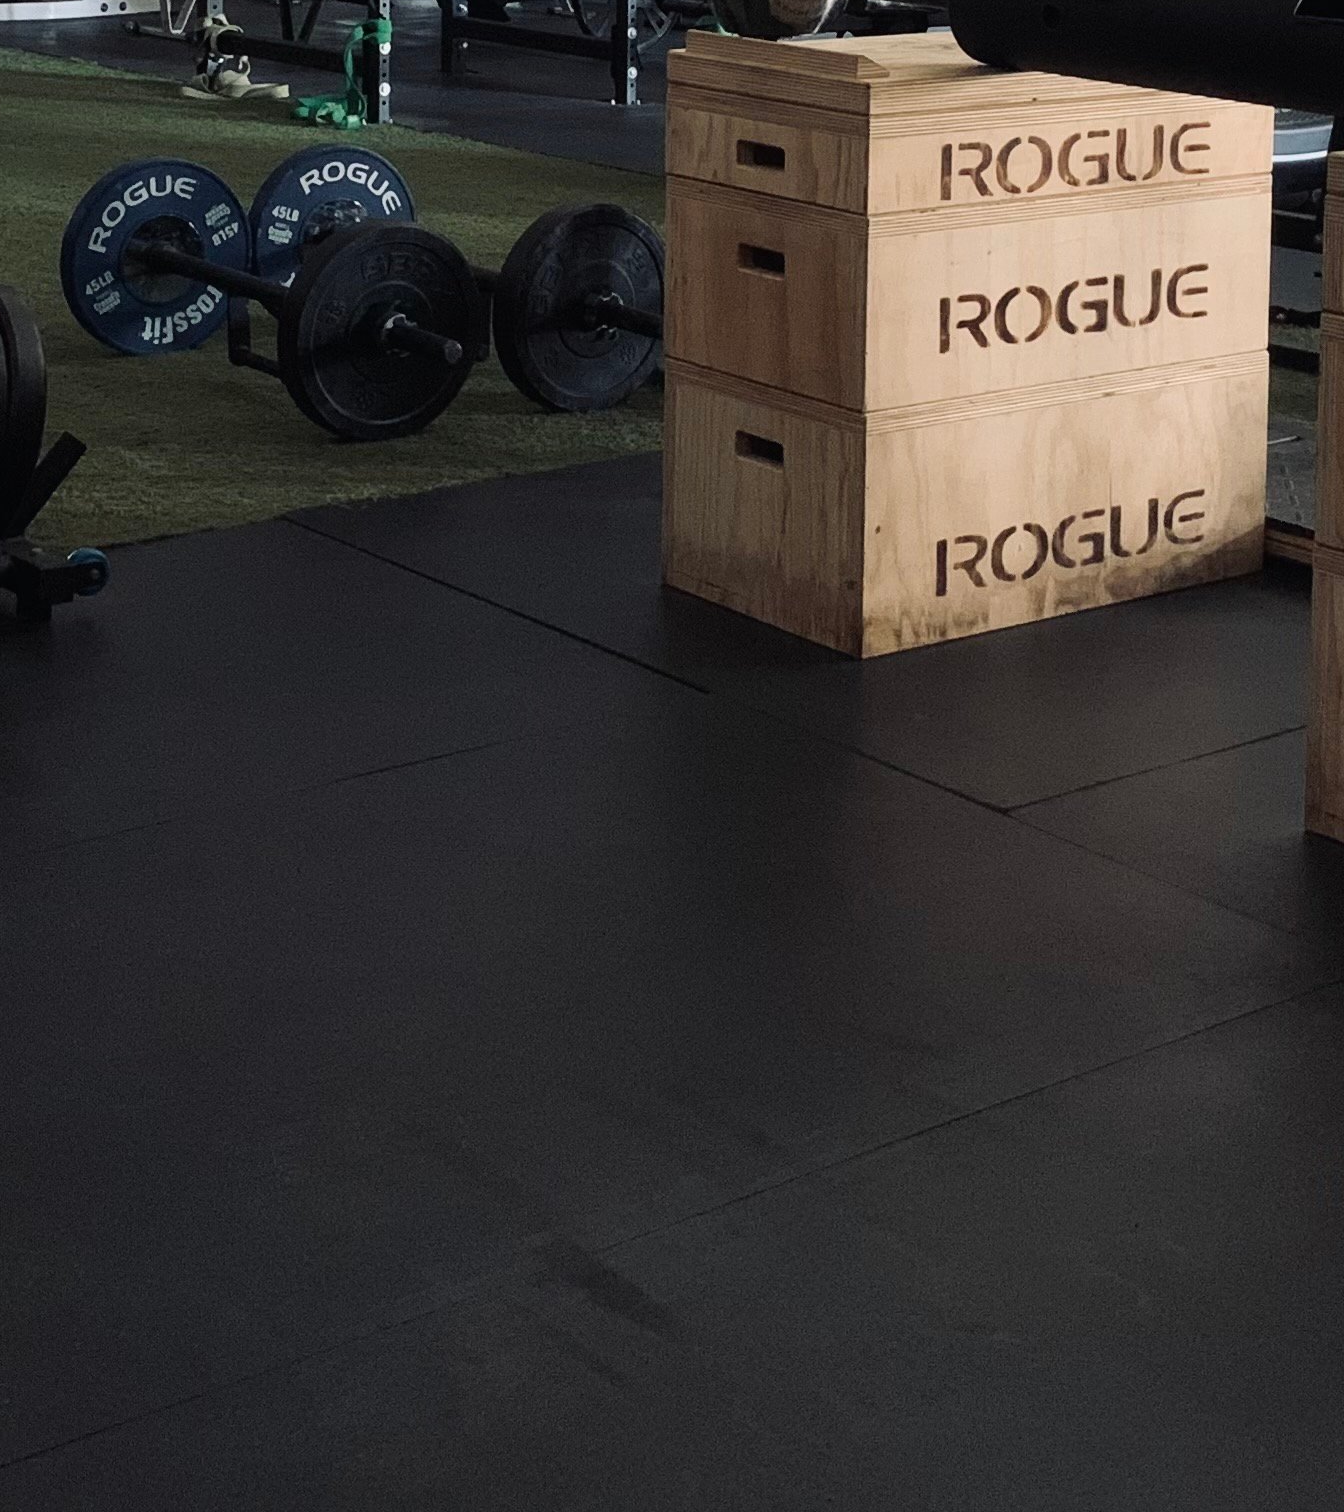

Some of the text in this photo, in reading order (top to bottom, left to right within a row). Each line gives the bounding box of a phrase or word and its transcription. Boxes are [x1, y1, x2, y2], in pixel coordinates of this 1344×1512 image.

[299, 160, 403, 216] ROGUE
[939, 120, 1212, 202] ROGUE
[87, 174, 198, 254] ROGUE
[271, 204, 300, 222] 45LB
[141, 284, 224, 345] rossFit
[938, 263, 1209, 355] ROGUE
[935, 488, 1206, 598] ROGUE
